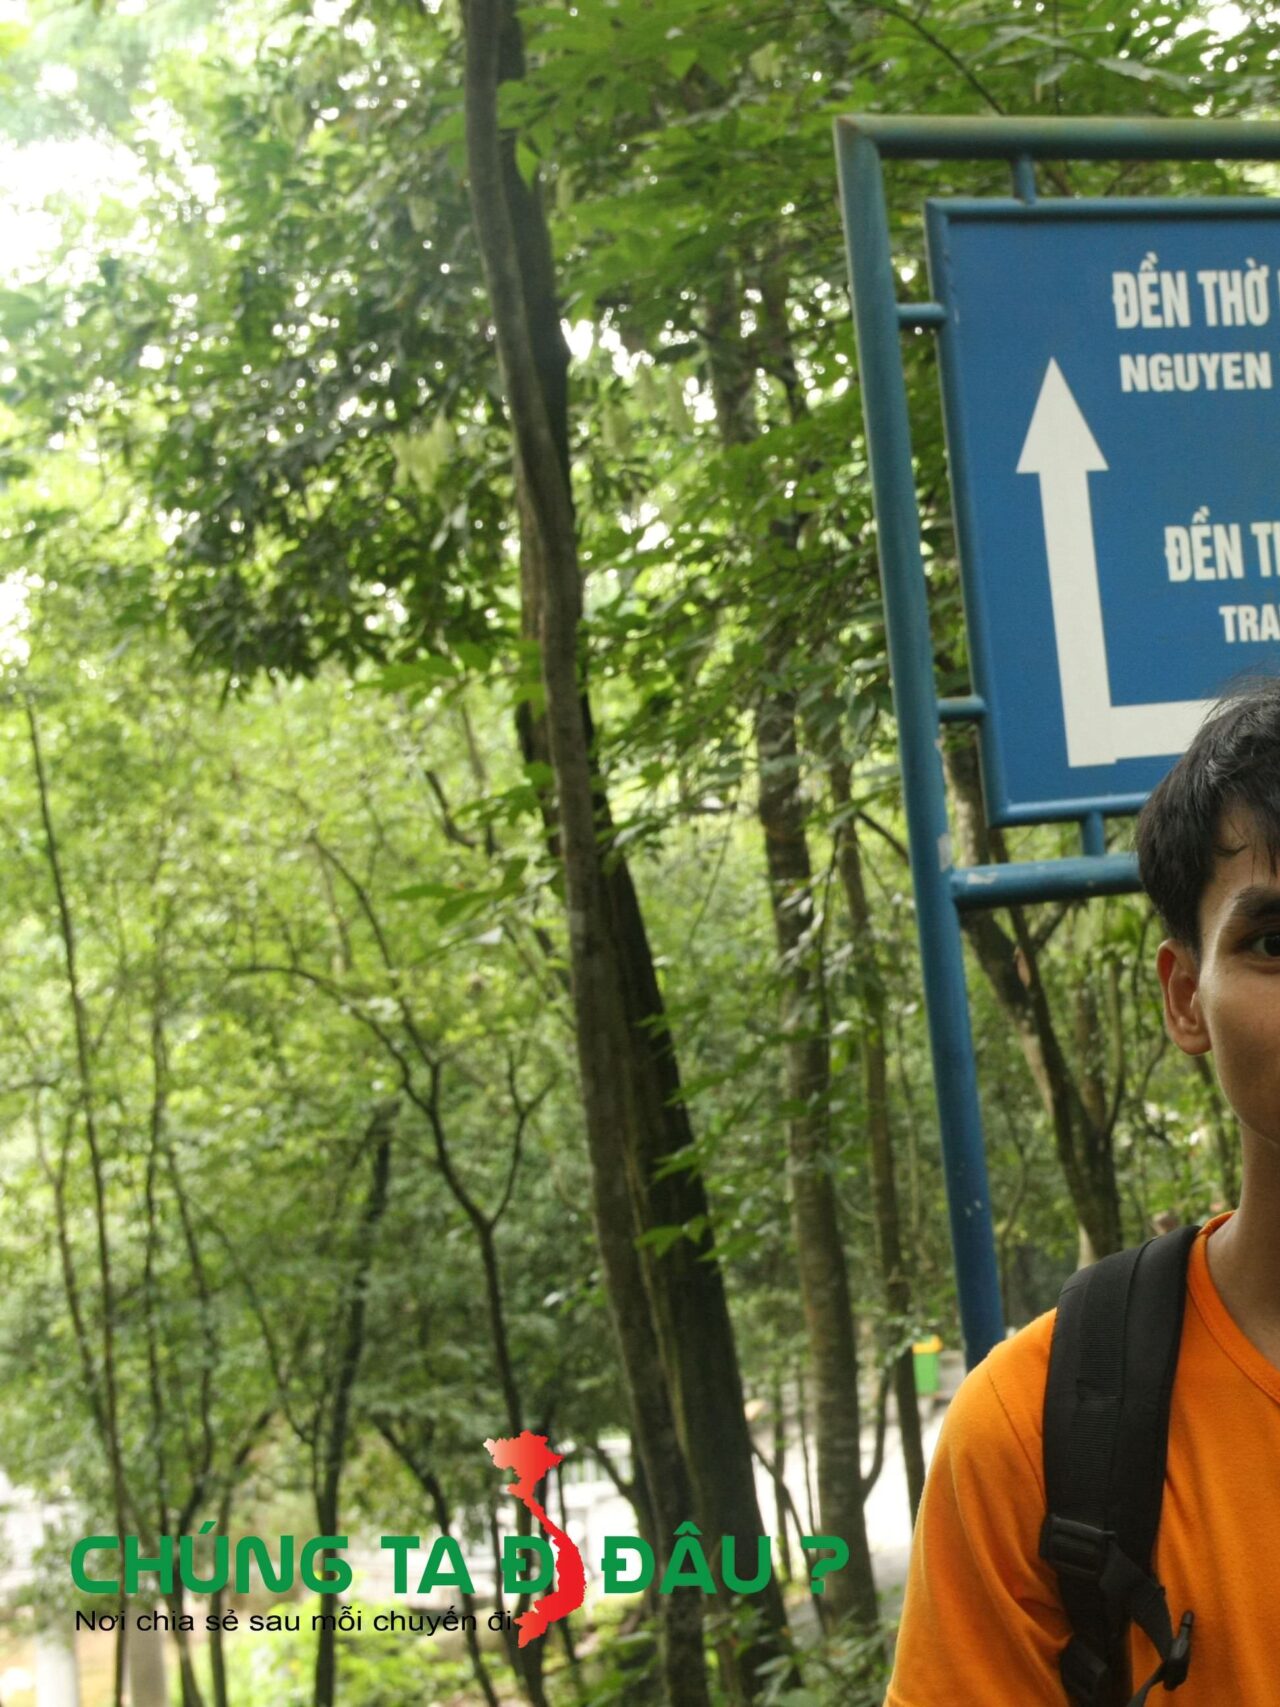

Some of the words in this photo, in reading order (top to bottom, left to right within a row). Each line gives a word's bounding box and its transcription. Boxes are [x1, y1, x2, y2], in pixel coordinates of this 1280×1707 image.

[1112, 251, 1190, 329] ĐỀN
[1197, 257, 1269, 327] THỜ
[1119, 351, 1273, 392] NGUYEN
[1164, 505, 1244, 582] ĐỀN
